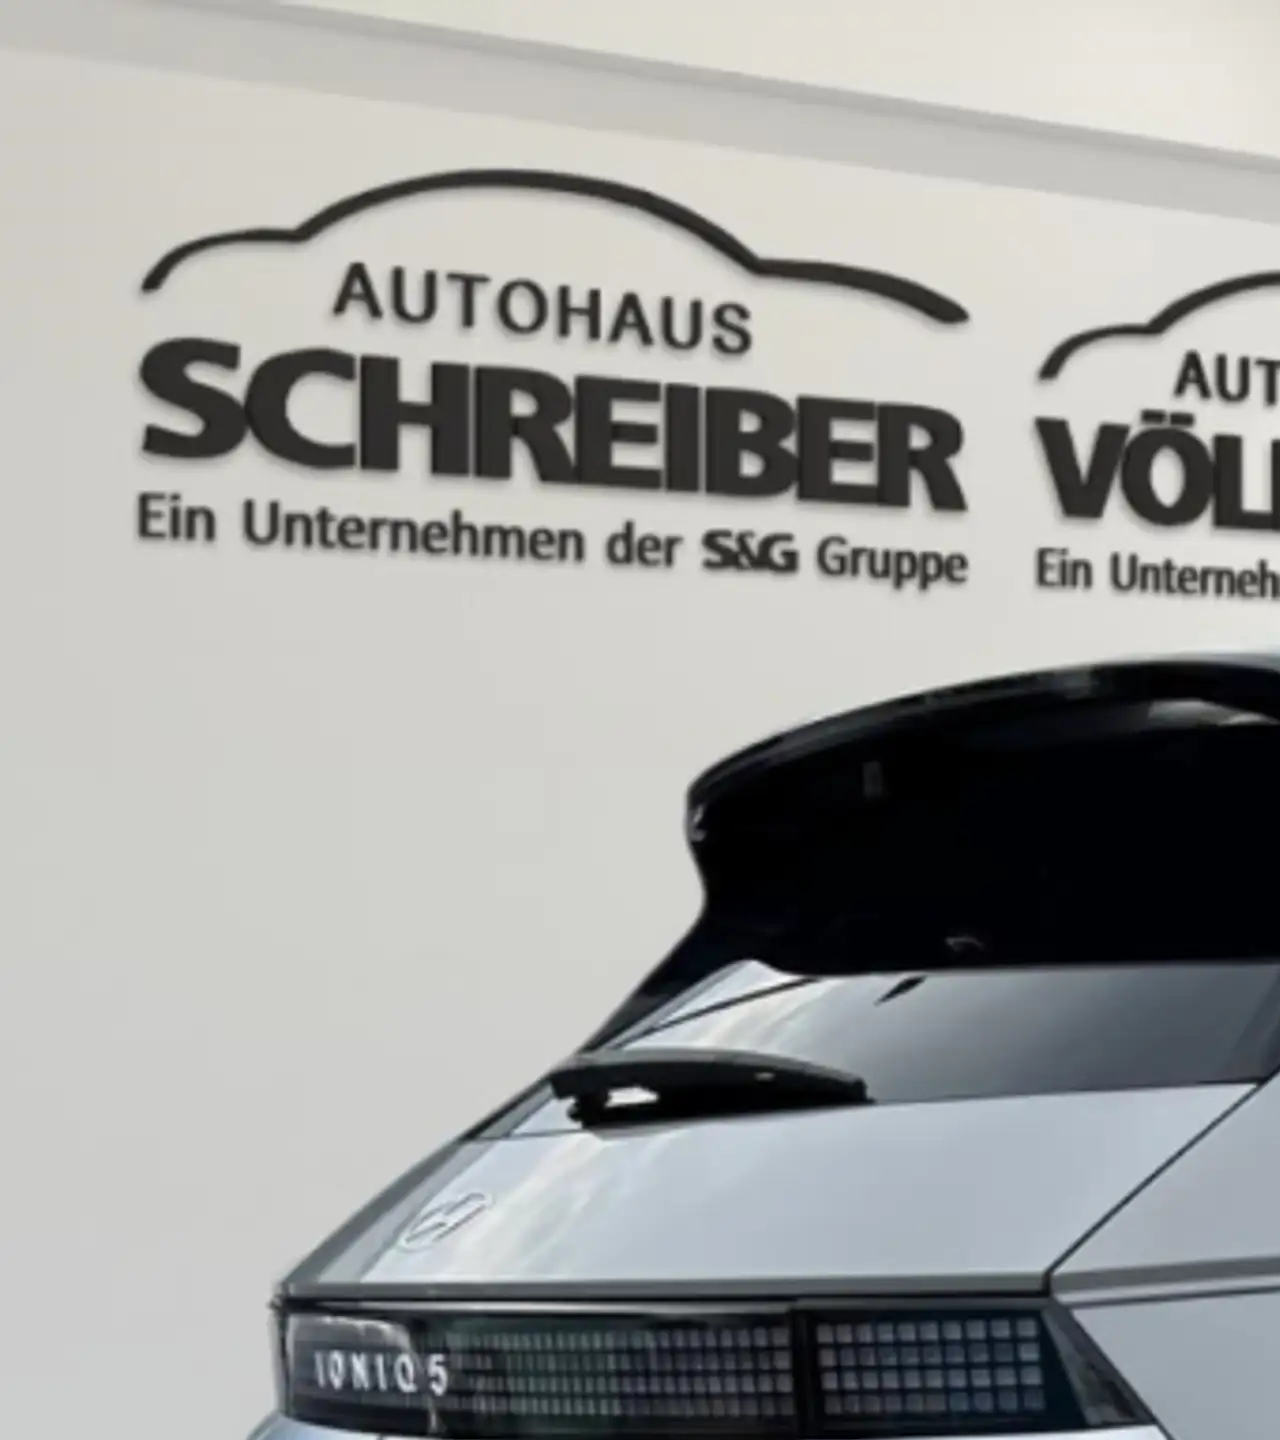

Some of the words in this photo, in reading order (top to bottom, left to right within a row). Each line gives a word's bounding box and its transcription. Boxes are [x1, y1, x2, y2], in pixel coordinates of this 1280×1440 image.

[332, 262, 753, 356] AUTOHAUS
[138, 336, 969, 513] SCHREIBER
[137, 491, 217, 543] Ein
[242, 498, 586, 564] Unternehmen
[606, 519, 683, 569] der
[701, 528, 800, 576] S&G
[815, 535, 970, 592] Gruppe
[1035, 546, 1094, 590] Ein
[314, 1349, 417, 1393] IONIQ
[427, 1352, 449, 1396] 5
